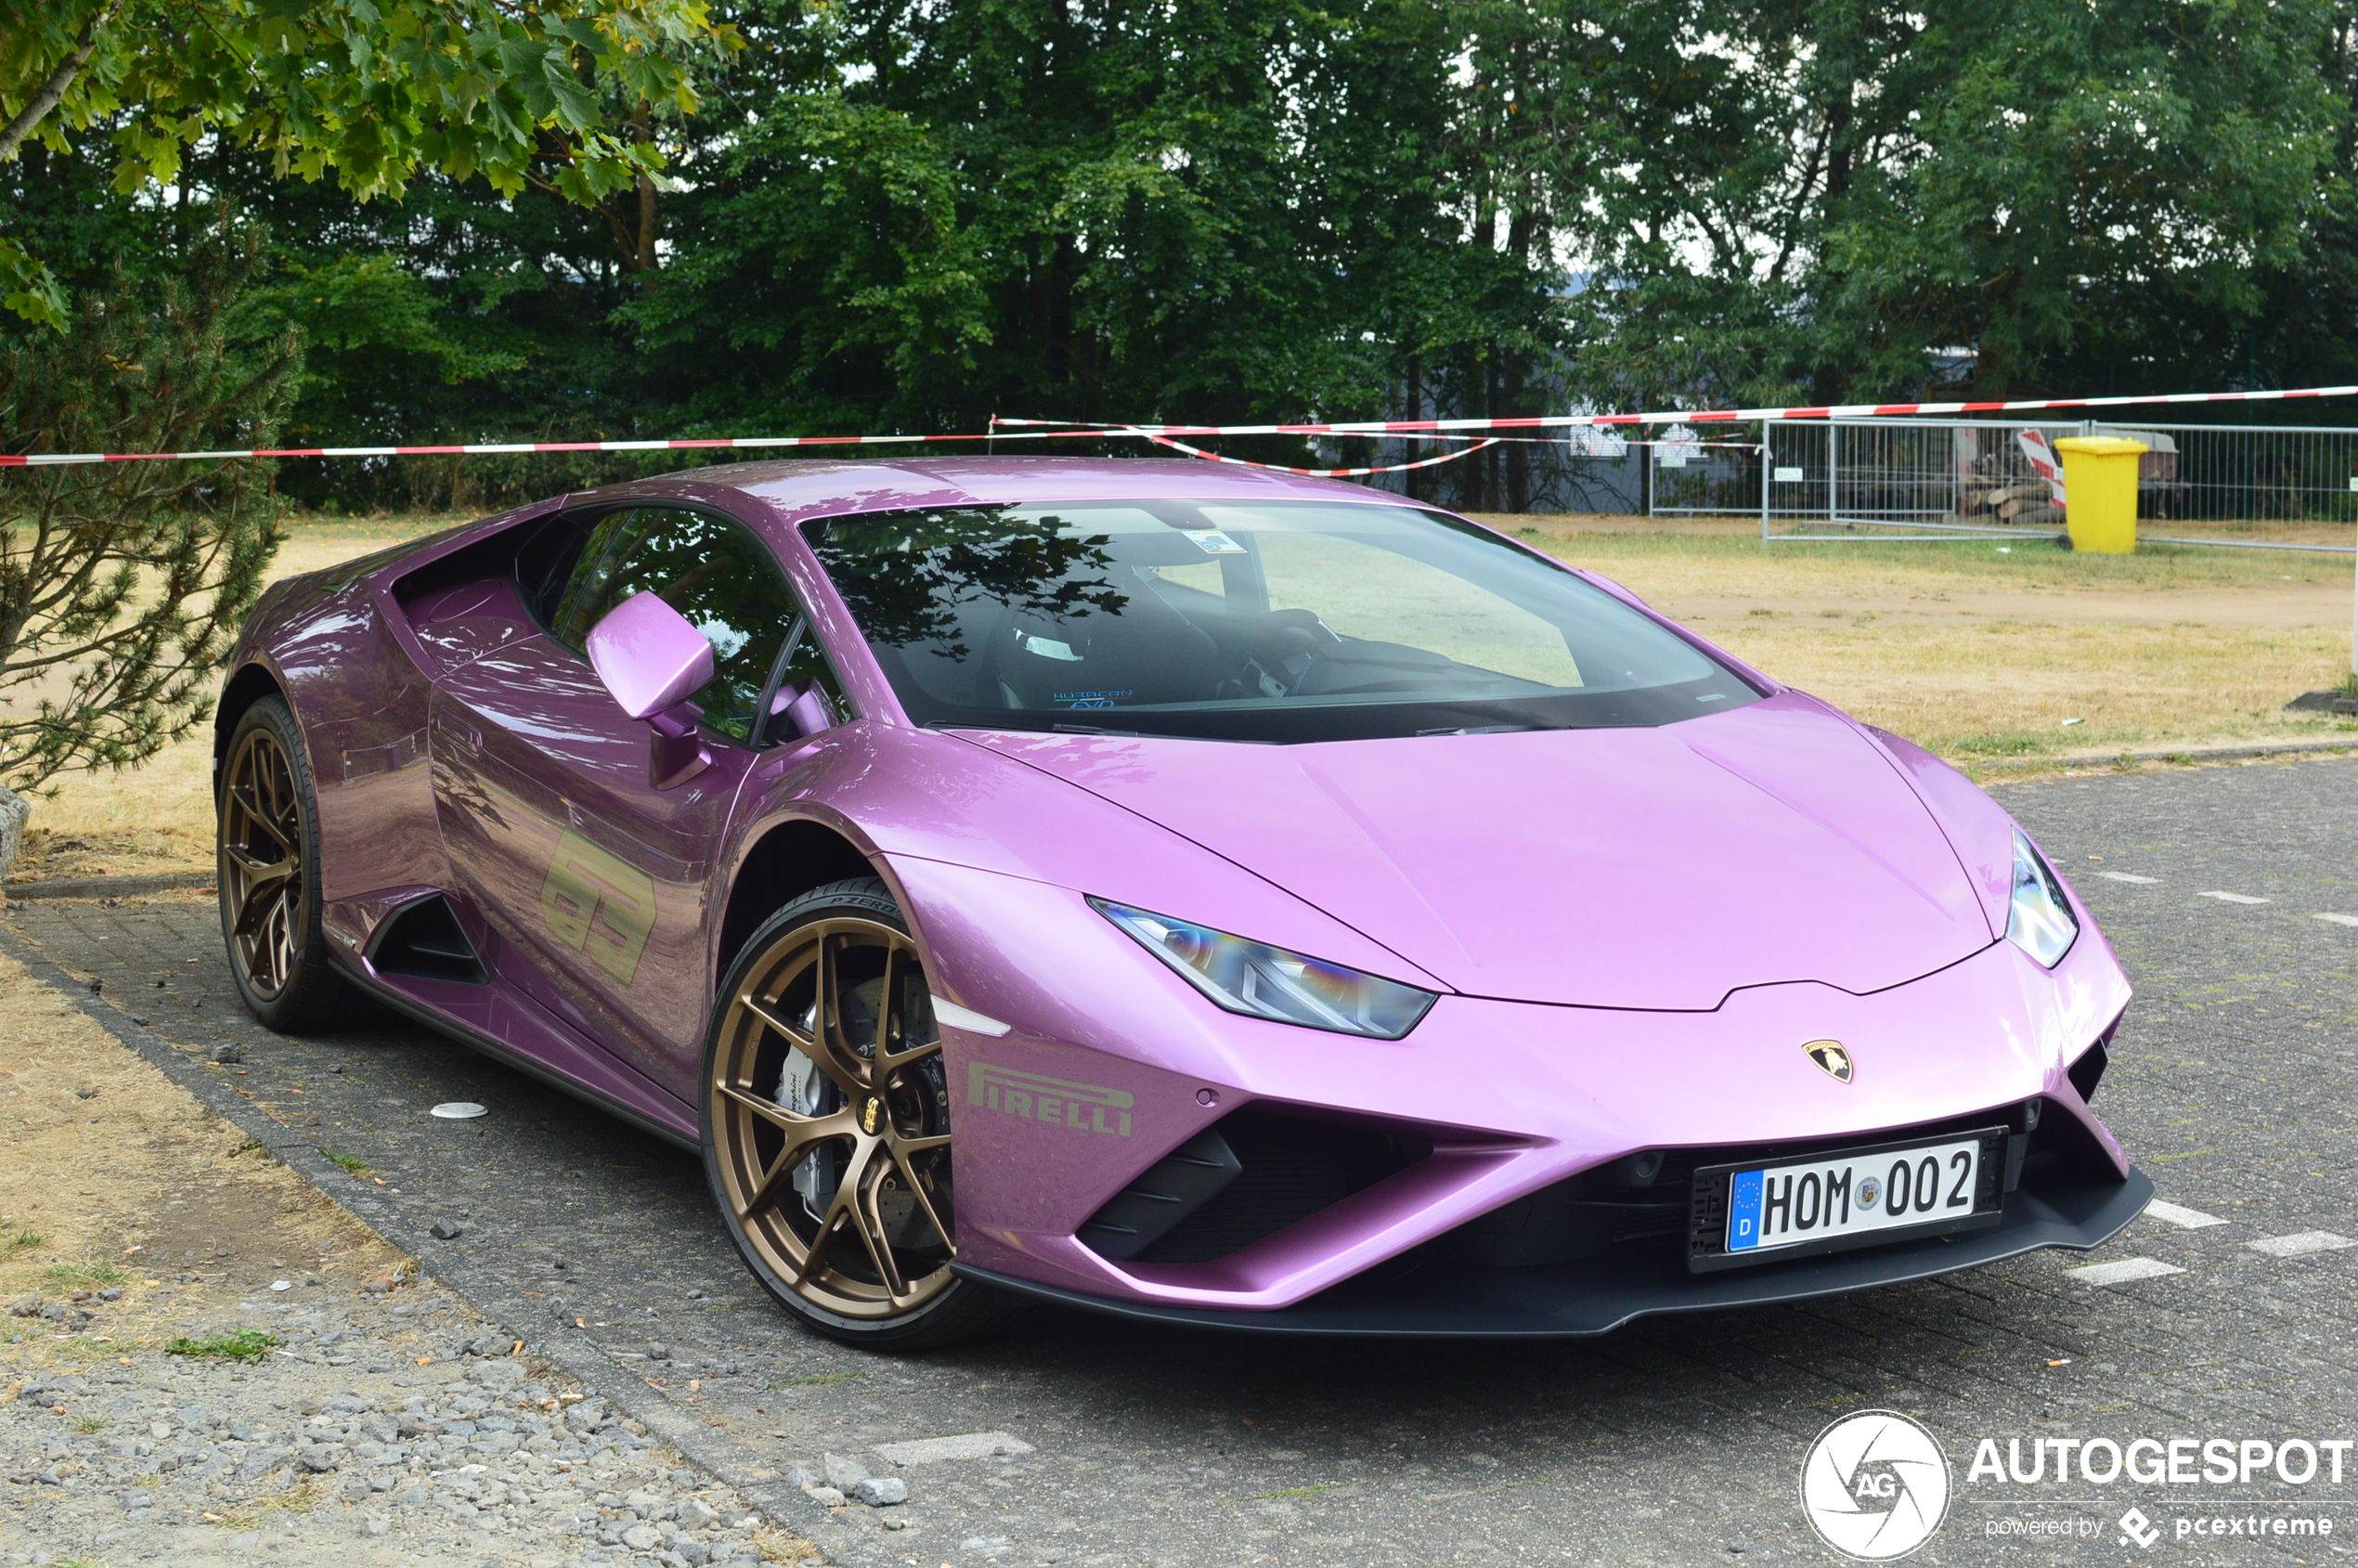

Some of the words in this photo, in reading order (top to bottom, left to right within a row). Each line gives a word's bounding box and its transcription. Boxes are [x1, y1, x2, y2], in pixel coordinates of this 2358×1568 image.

[540, 827, 657, 988] 63
[830, 897, 844, 905] P
[845, 897, 897, 913] ZERO
[863, 1096, 879, 1134] BBS
[968, 1060, 1134, 1137] PIRELLI
[1739, 1218, 1751, 1236] D
[1763, 1166, 1853, 1236] HOM
